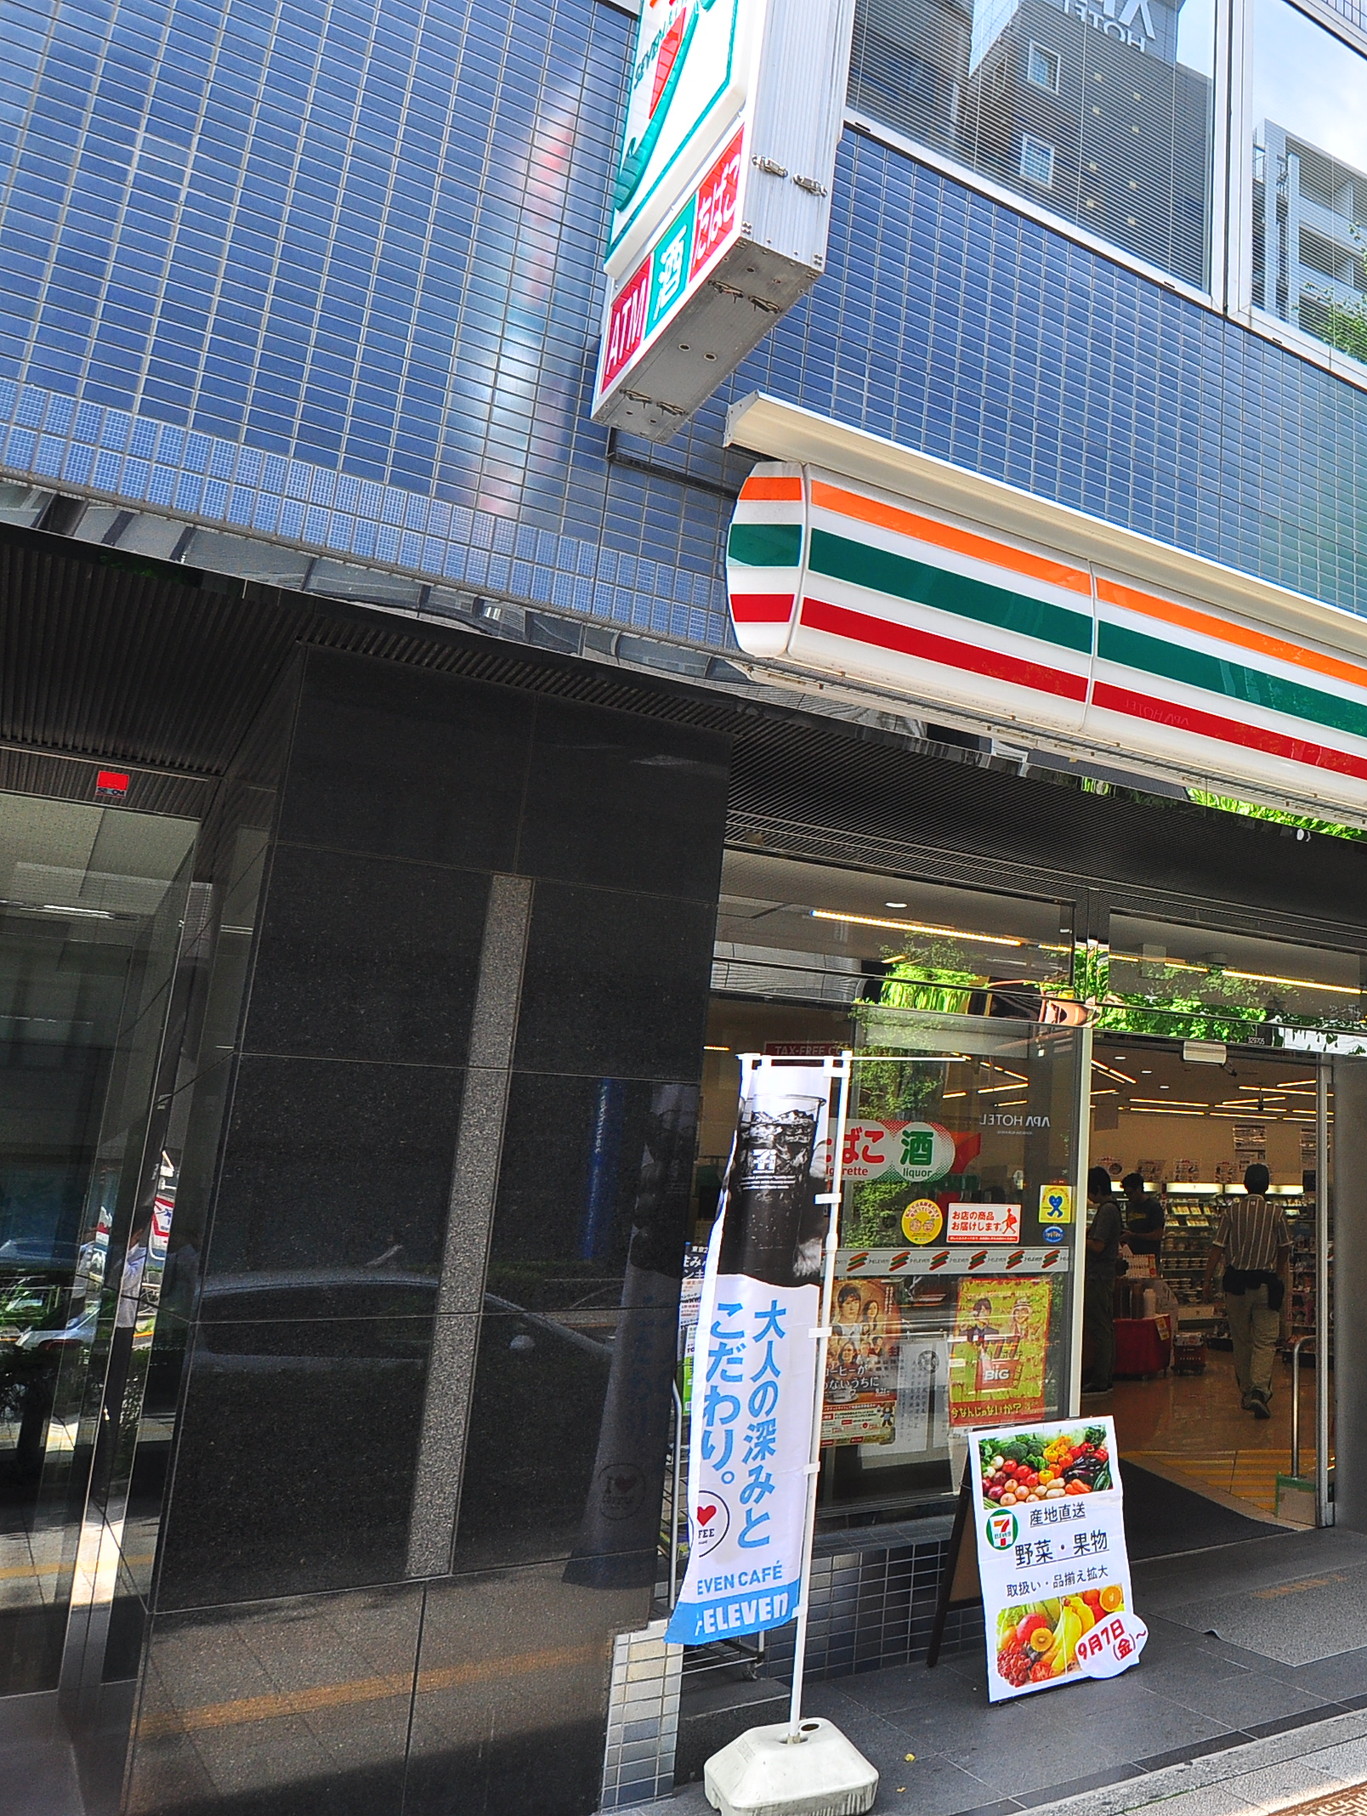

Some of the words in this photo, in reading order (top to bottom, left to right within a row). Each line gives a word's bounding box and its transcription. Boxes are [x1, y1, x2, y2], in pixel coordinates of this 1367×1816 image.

[691, 152, 741, 267] たばこ
[653, 222, 687, 321] 酒
[606, 277, 647, 375] ATM
[774, 1045, 825, 1055] TAX-FREE
[900, 1129, 934, 1166] 酒
[826, 1167, 869, 1177] igrette
[902, 1167, 933, 1179] liquor
[952, 1211, 995, 1221] お店の商品
[984, 1369, 1010, 1381] BIG
[701, 1302, 747, 1485] こだわり。
[737, 1300, 787, 1549] 大人の深みと
[1029, 1502, 1086, 1527] 産地直送
[1015, 1529, 1109, 1567] 野菜・果物
[738, 1560, 783, 1587] CAFÉ
[1006, 1564, 1109, 1598] 取扱い・品揃え拡大
[1077, 1618, 1125, 1660] 9月7日
